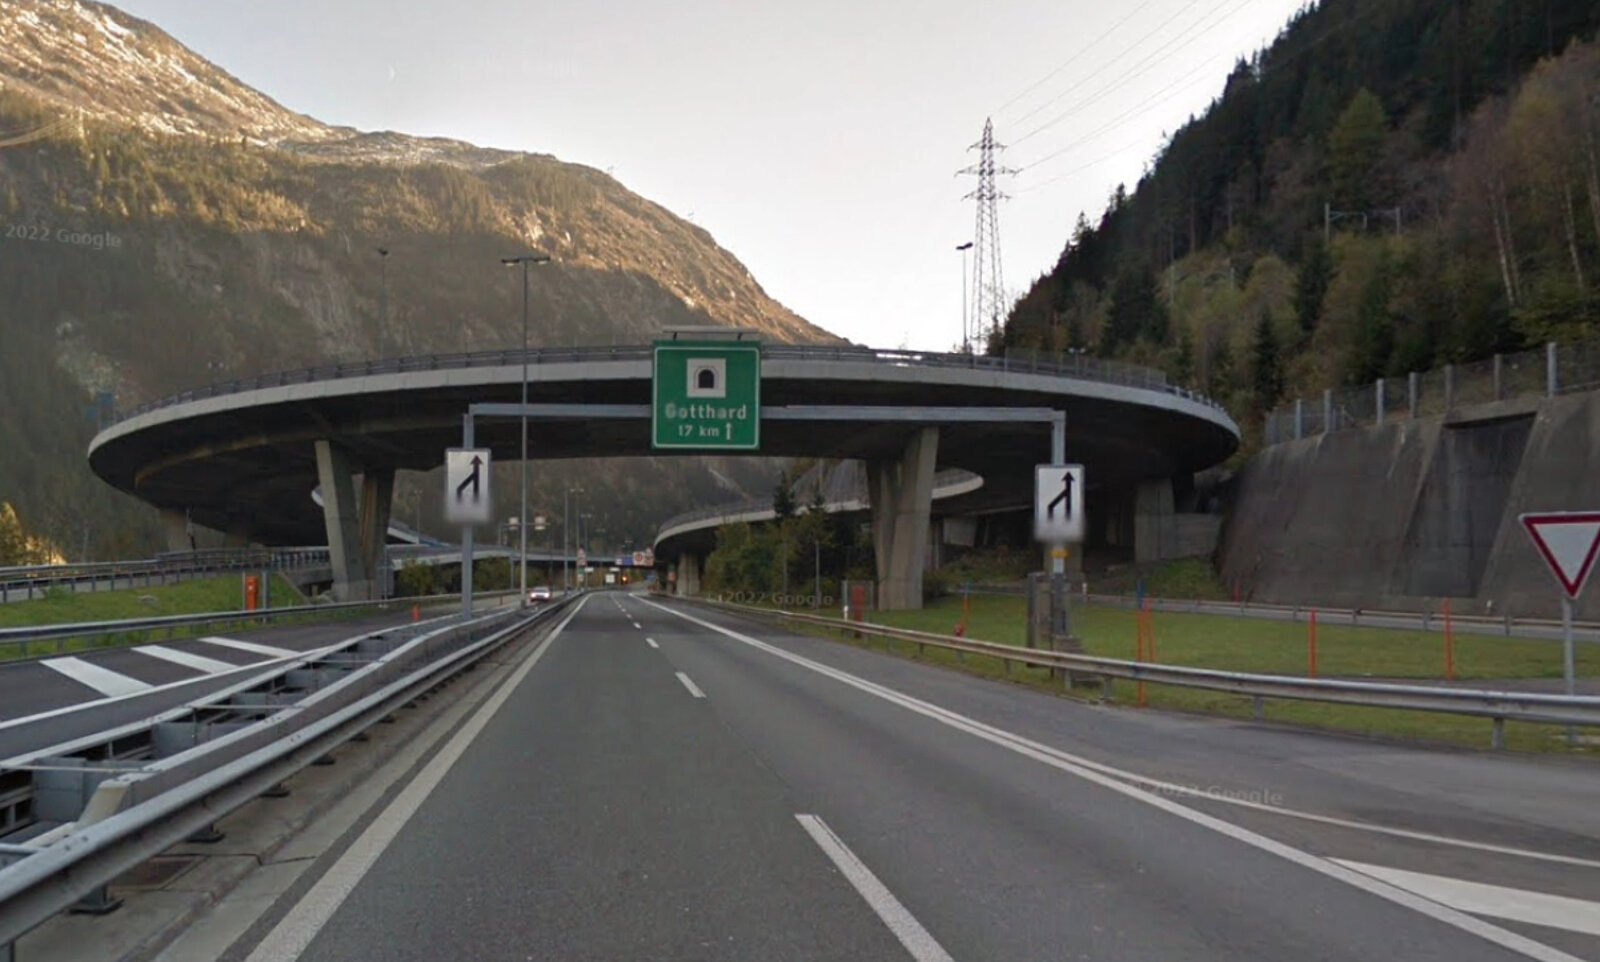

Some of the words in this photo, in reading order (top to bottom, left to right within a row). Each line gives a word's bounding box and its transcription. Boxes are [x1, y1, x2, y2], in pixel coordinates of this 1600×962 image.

[665, 403, 747, 419] Gotthard
[678, 424, 693, 437] 17
[699, 425, 720, 437] km
